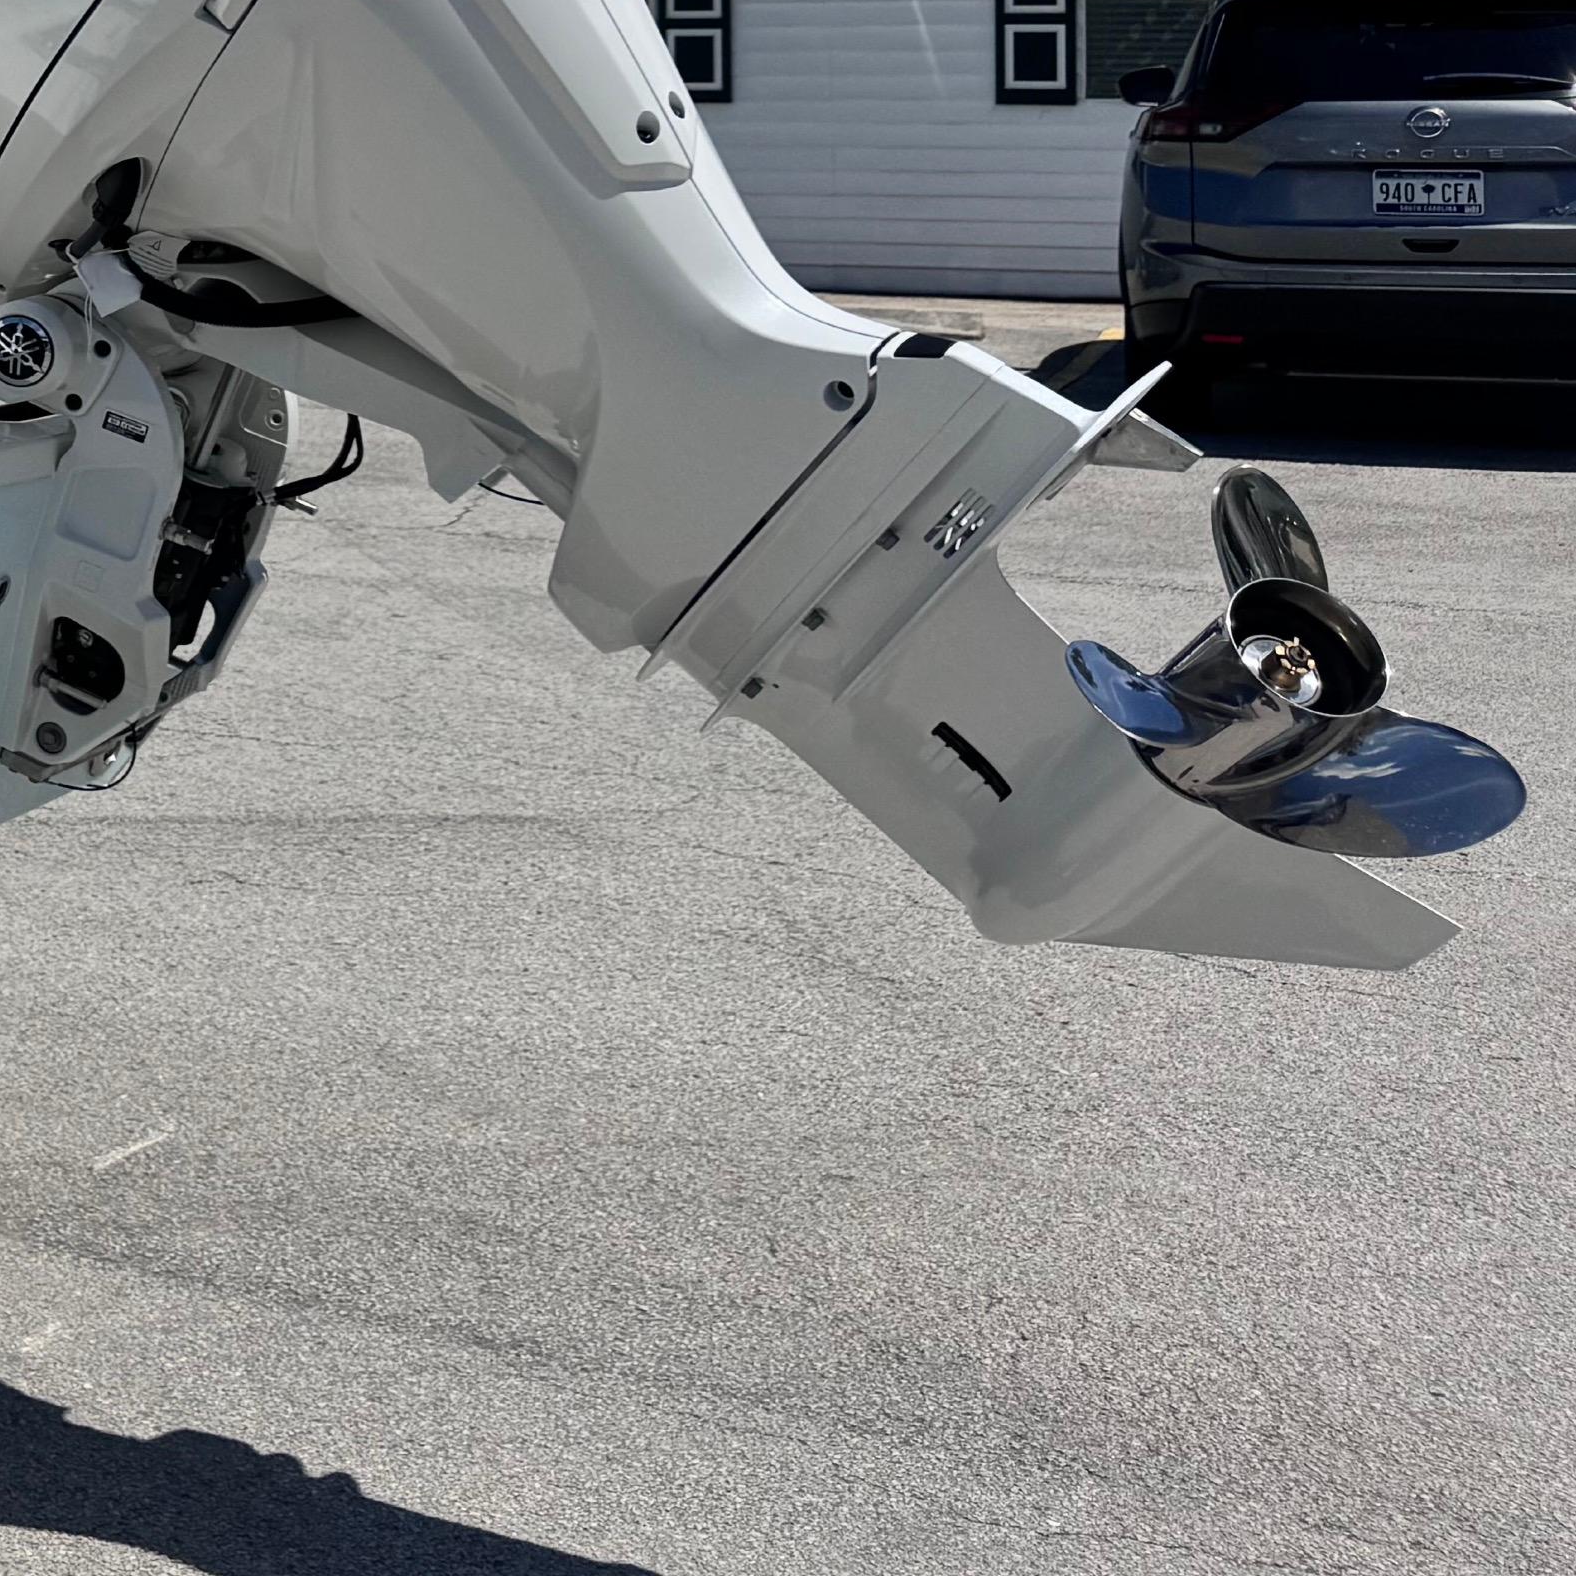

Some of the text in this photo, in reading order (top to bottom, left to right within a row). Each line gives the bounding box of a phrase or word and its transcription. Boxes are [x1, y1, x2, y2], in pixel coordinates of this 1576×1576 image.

[1350, 147, 1504, 160] ROGUE
[1379, 182, 1477, 203] 940 CFA
